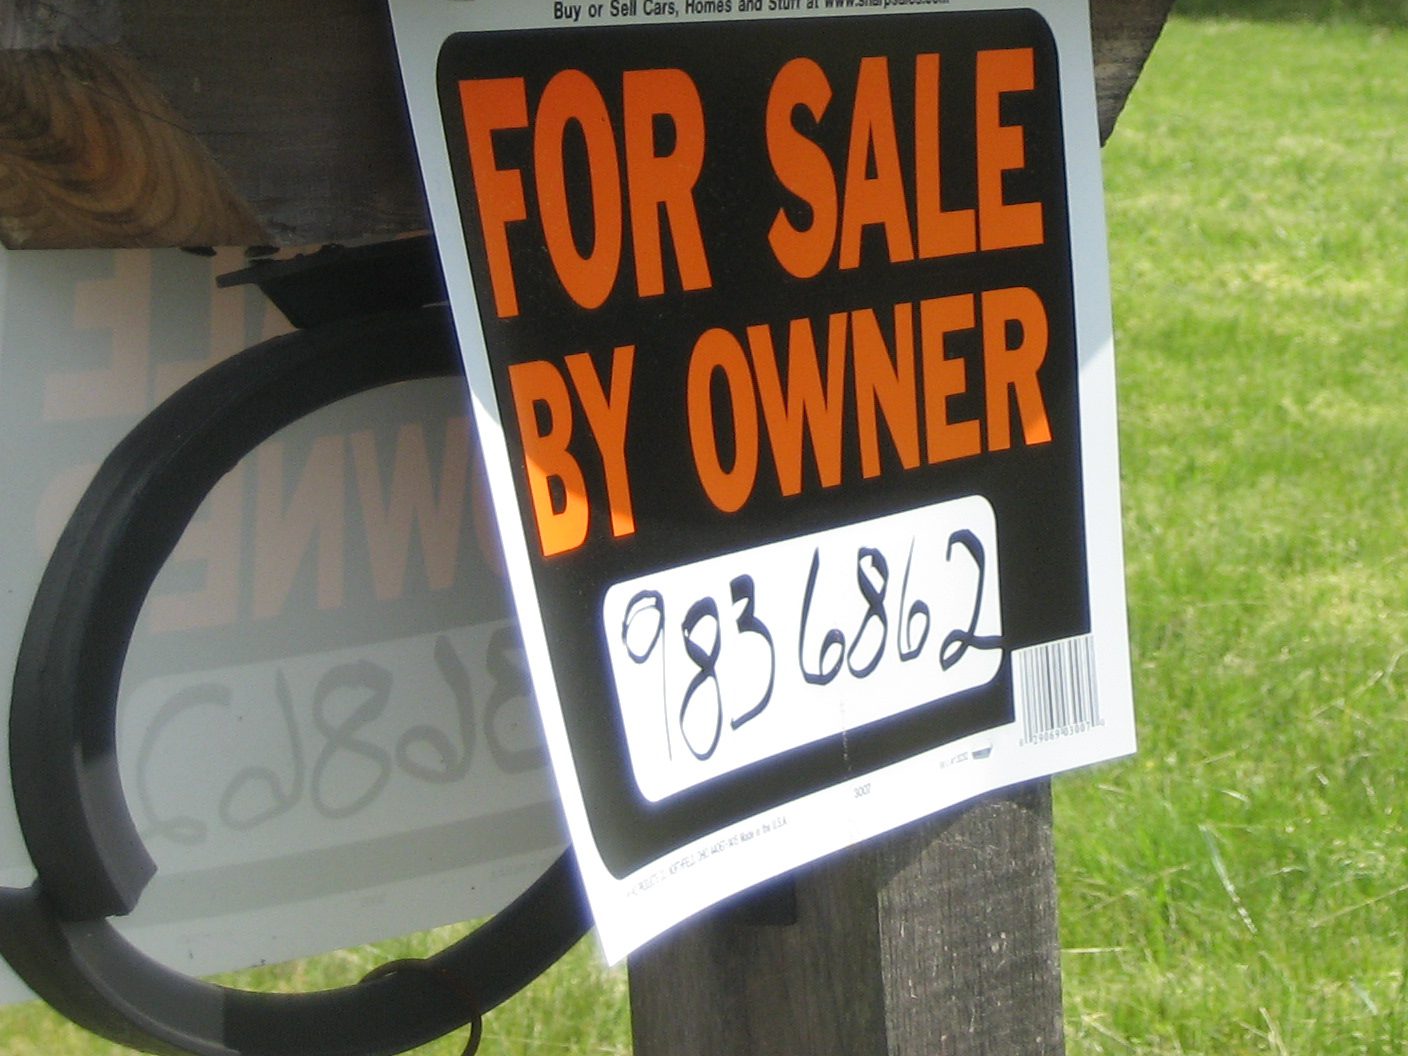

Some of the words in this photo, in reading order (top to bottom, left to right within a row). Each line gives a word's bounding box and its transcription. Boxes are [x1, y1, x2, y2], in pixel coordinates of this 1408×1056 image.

[553, 0, 581, 22] Buy
[588, 3, 602, 17] or
[458, 68, 713, 318] FOR
[765, 47, 1044, 279] SALE
[508, 345, 635, 556] BY
[687, 286, 1052, 514] OWNER
[852, 783, 872, 799] 3007
